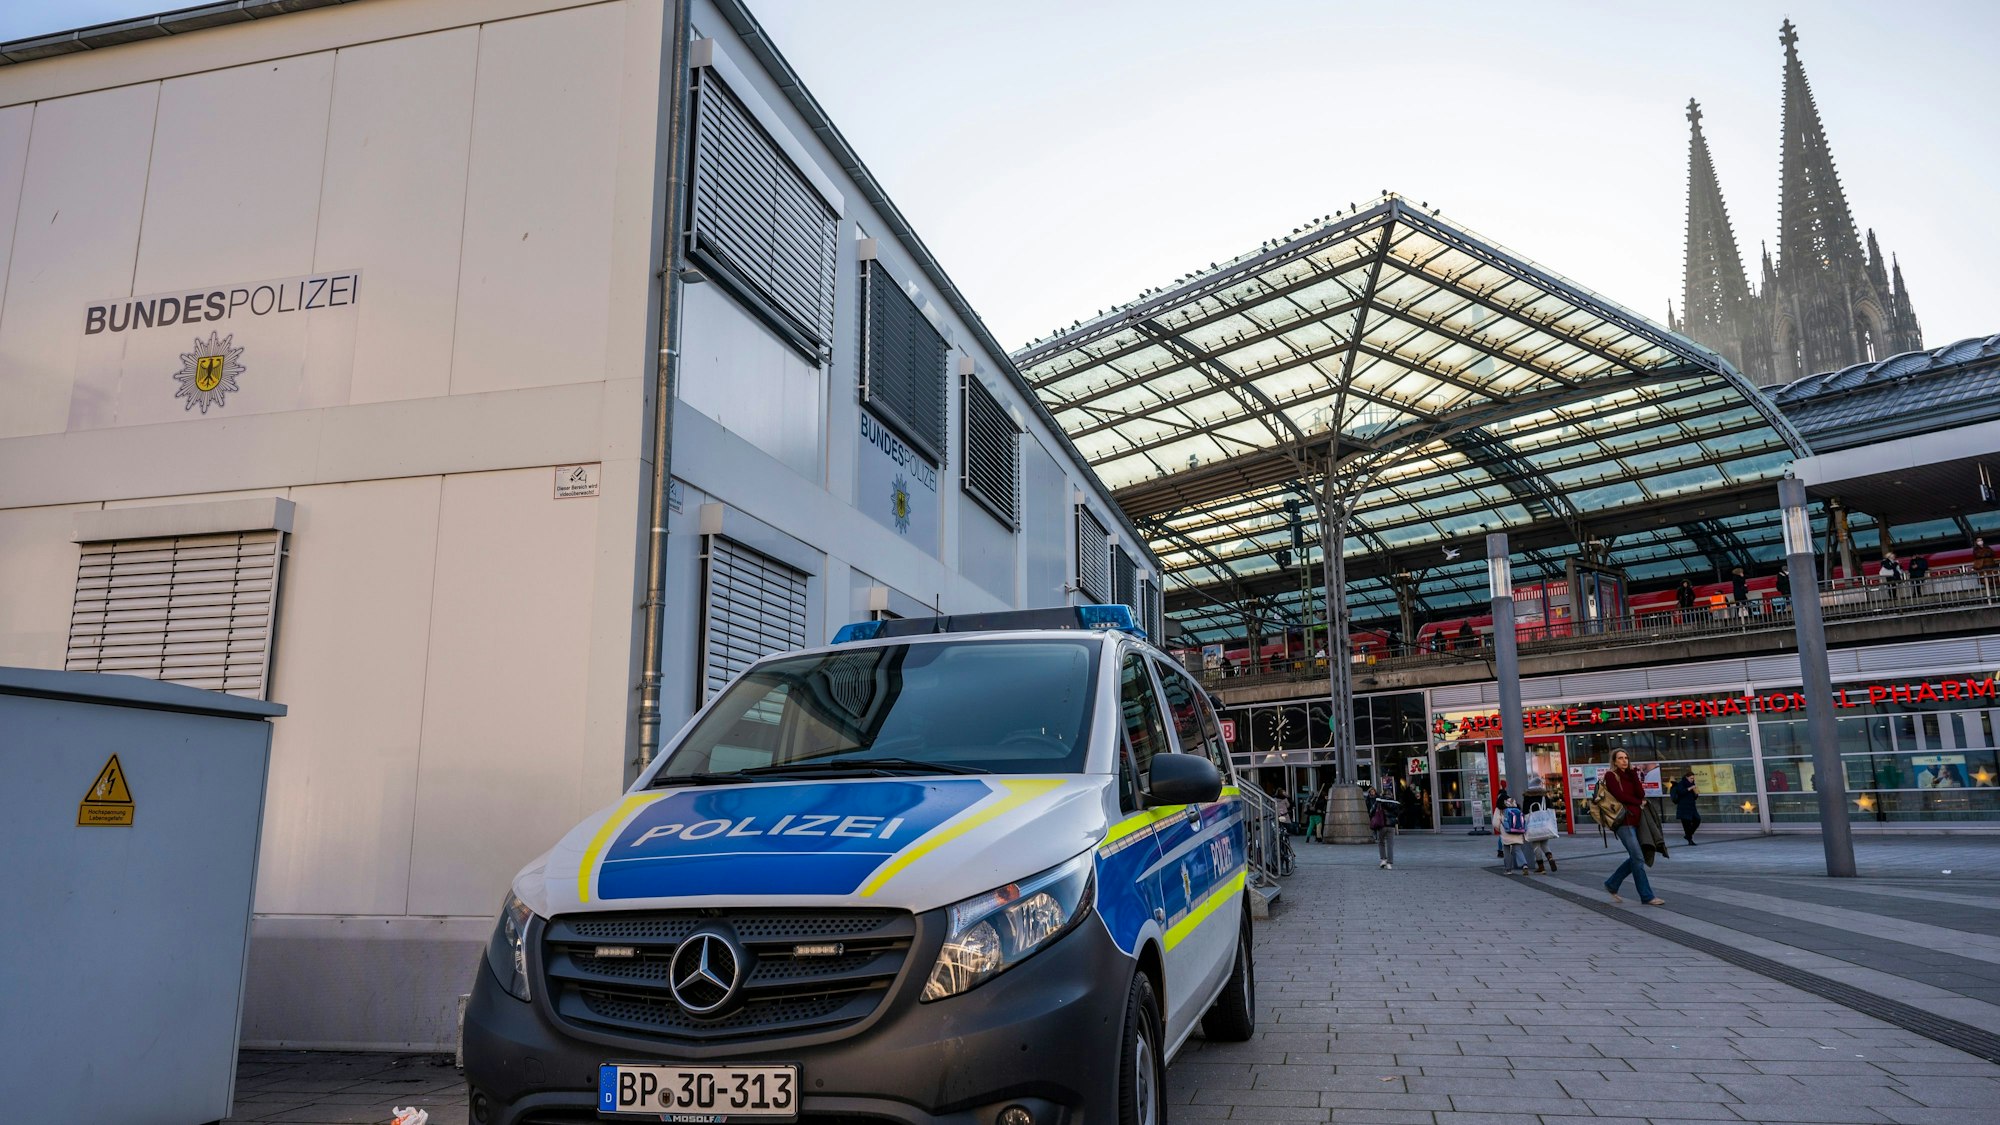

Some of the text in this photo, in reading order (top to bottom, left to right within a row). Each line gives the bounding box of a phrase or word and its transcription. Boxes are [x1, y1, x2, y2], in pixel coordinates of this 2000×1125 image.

[84, 274, 358, 335] BUNDESPOLIZEI
[861, 411, 937, 494] BUNDESPOLIZEI
[1459, 708, 1580, 733] APOHEKE
[1619, 688, 1856, 723] INTERNATIONL
[630, 814, 905, 848] POLIZEI
[1210, 836, 1233, 880] POLIZEI
[605, 1092, 612, 1103] D
[619, 1072, 658, 1107] BP
[672, 1115, 717, 1123] MOSOLF
